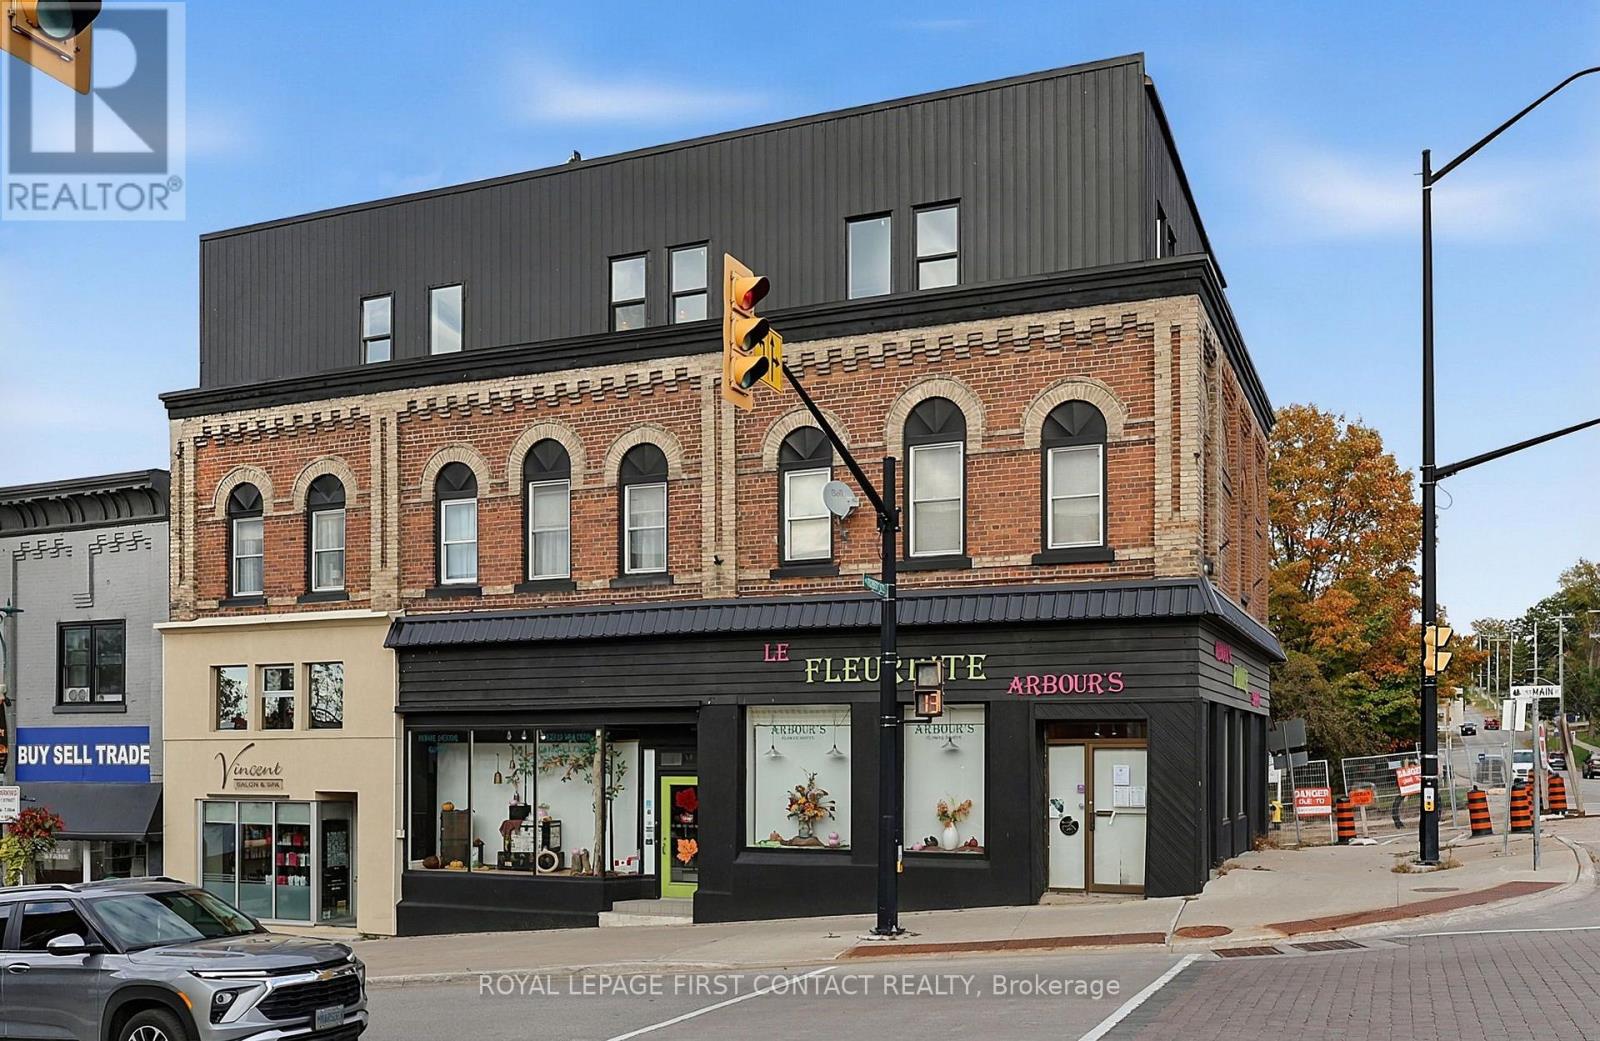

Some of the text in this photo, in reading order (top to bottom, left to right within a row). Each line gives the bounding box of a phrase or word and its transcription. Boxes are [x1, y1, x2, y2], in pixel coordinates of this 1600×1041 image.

[763, 643, 790, 662] LE
[1007, 671, 1124, 696] ARBOUR'S
[1532, 687, 1554, 696] MAIN
[771, 724, 826, 735] ARBOUR'S
[915, 723, 975, 735] ARBOUR'S
[18, 745, 150, 765] BUY SELL TRADE
[214, 742, 283, 790] Vincent
[1295, 789, 1329, 798] DANGER
